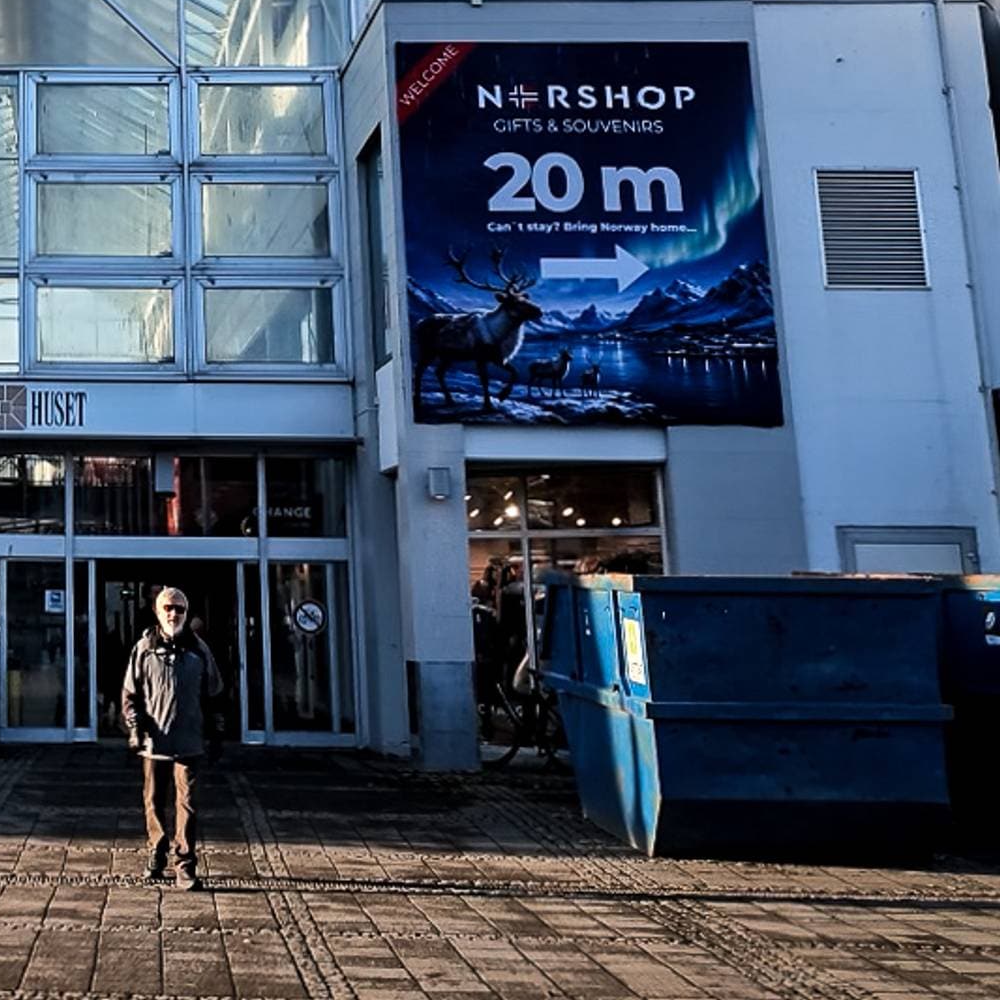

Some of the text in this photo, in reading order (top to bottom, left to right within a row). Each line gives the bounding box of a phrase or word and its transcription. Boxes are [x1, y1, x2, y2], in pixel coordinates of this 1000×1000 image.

[399, 43, 461, 106] WELCOME
[493, 118, 664, 135] GIFTS & SOUVENIRS
[483, 151, 685, 213] 20 m
[527, 220, 560, 234] stay?
[563, 220, 598, 235] Bring
[600, 221, 648, 234] Norway
[31, 391, 88, 427] HUSET
